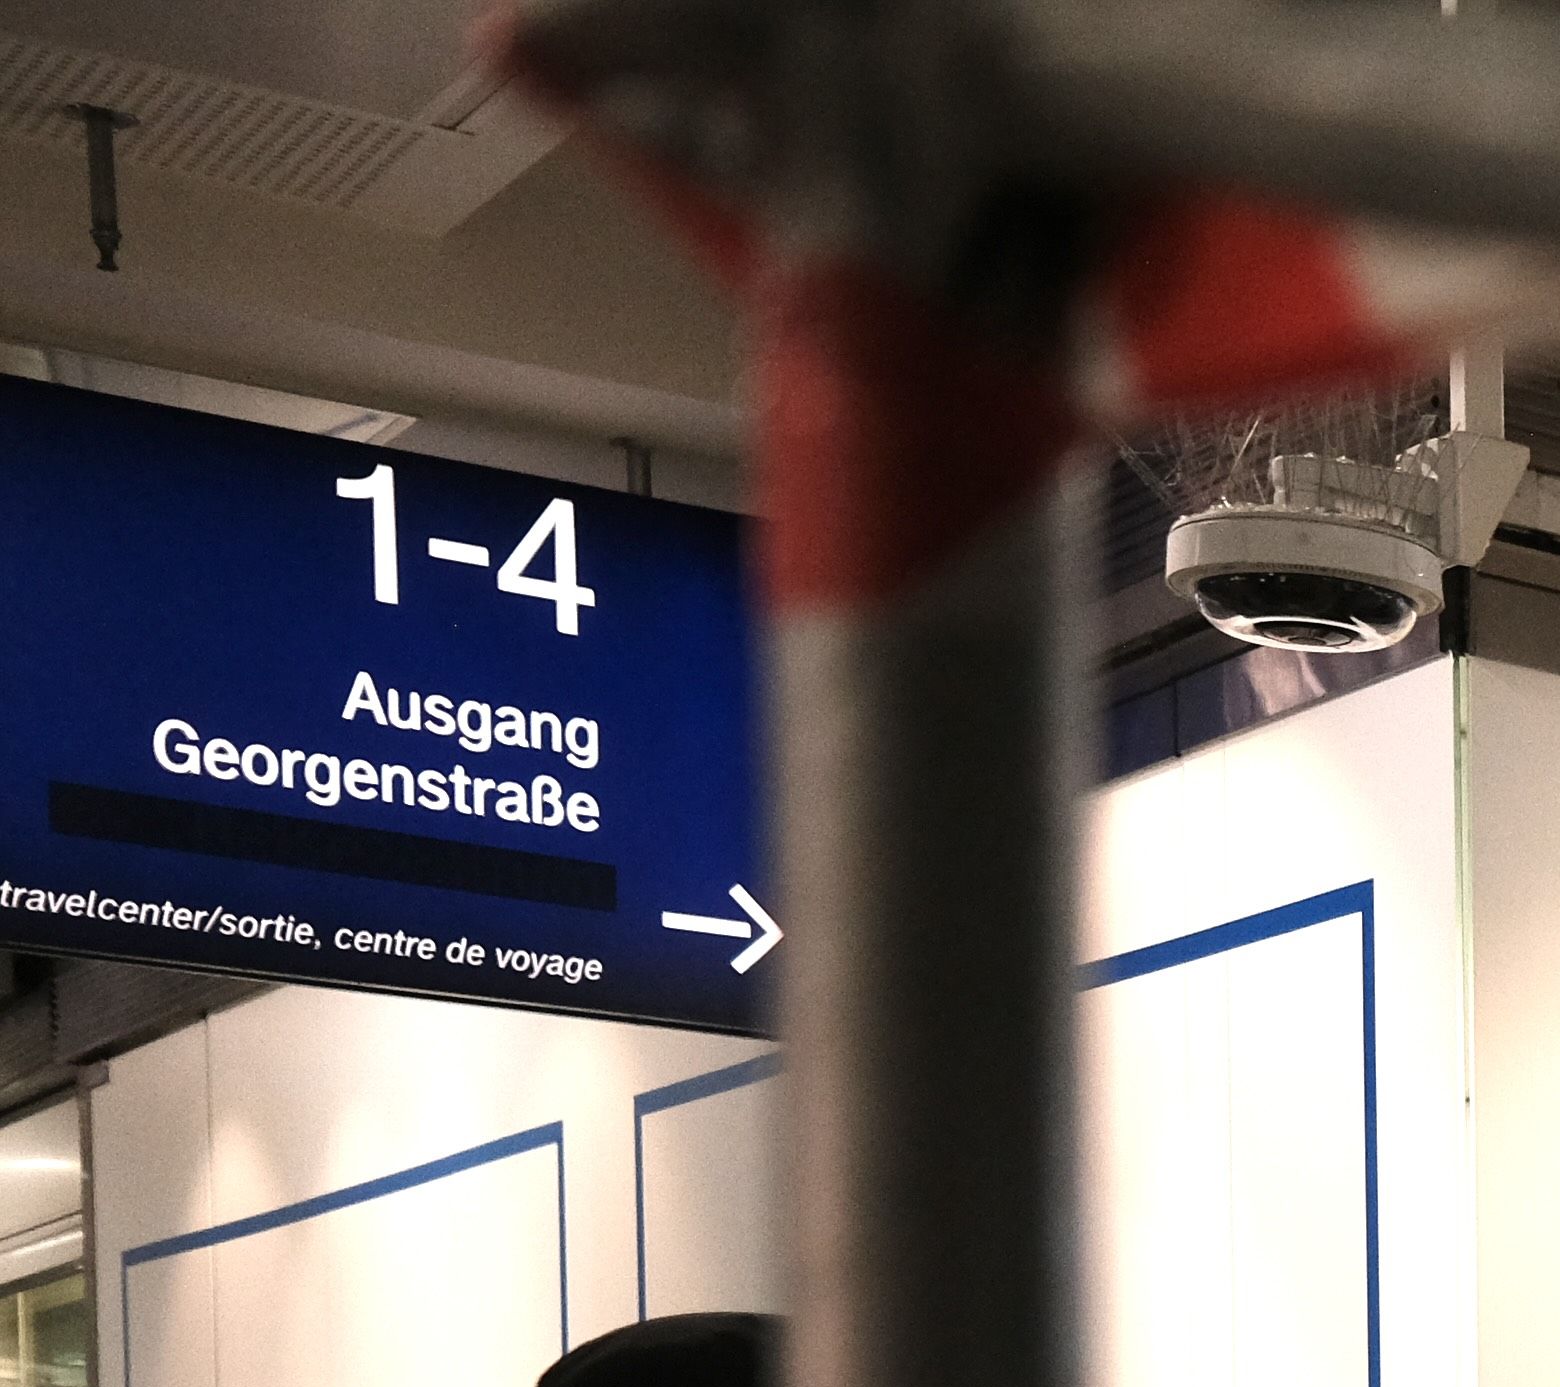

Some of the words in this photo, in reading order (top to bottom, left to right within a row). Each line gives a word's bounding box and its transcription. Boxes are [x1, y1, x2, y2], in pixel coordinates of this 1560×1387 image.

[336, 463, 595, 635] 1-4
[342, 671, 599, 769] Ausgang
[153, 719, 600, 832] Georgenstraße
[334, 928, 437, 960] centre
[446, 937, 486, 966] de
[496, 946, 603, 984] voyage
